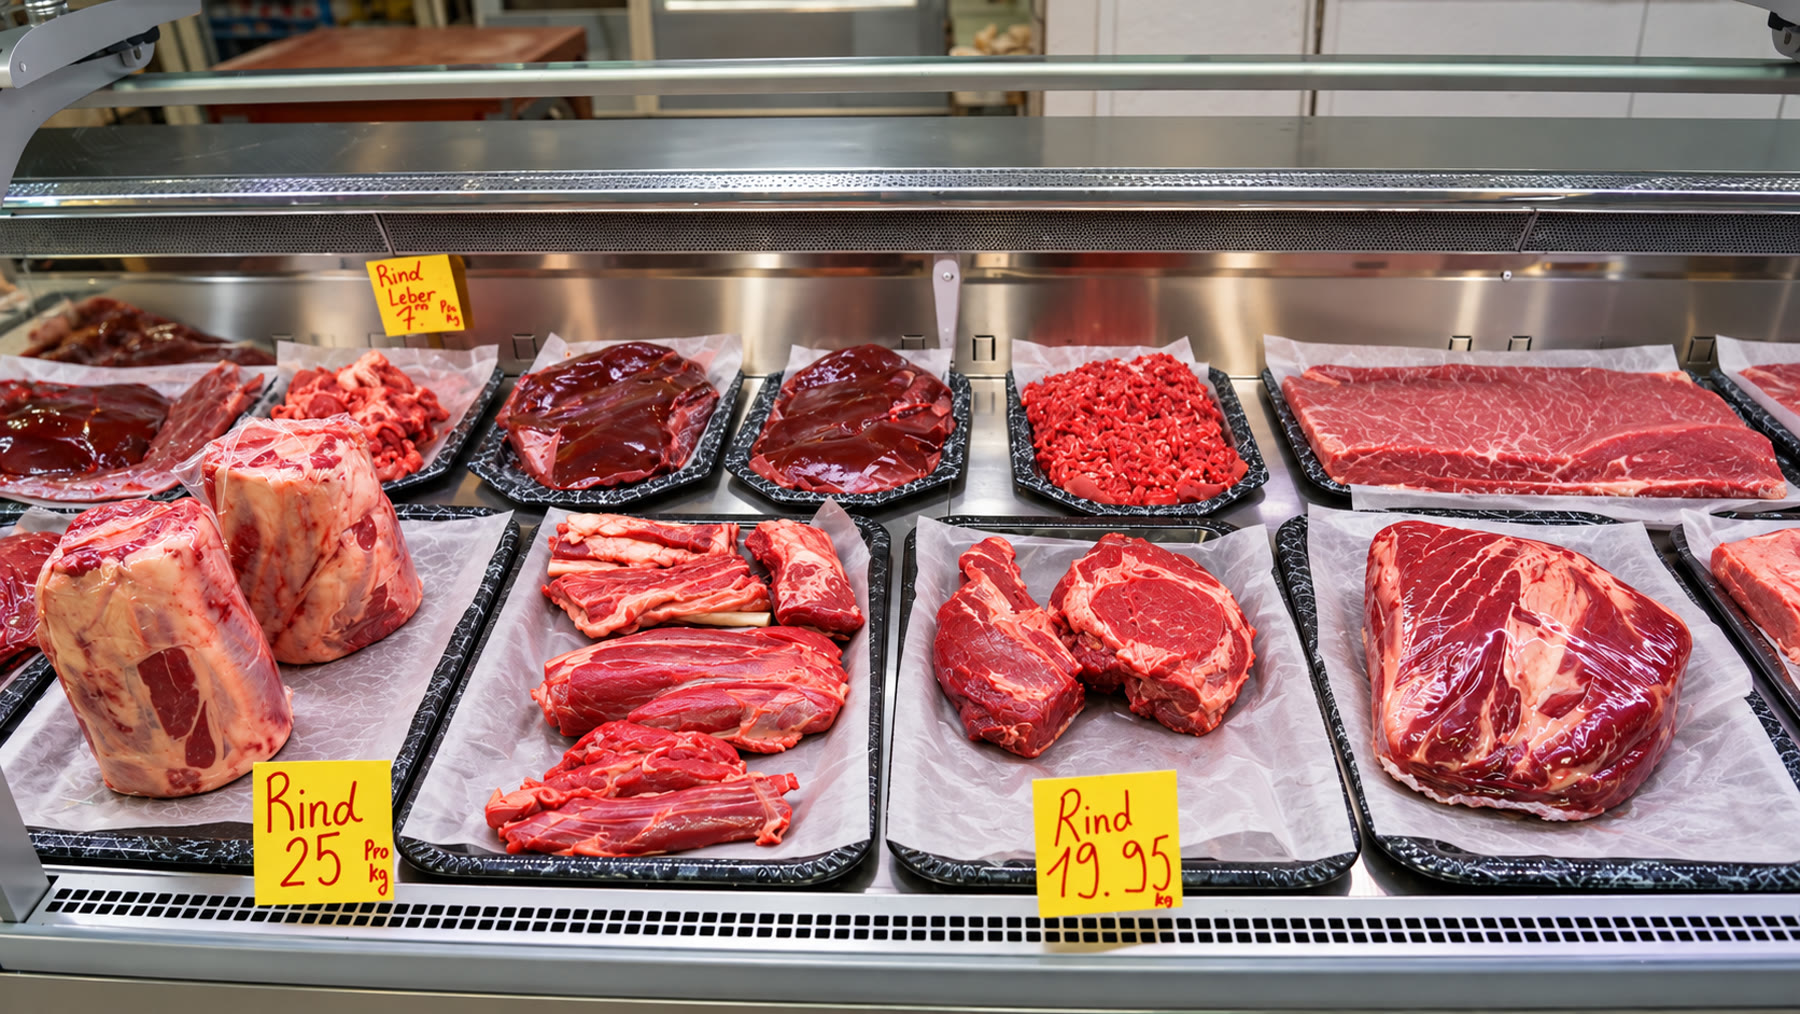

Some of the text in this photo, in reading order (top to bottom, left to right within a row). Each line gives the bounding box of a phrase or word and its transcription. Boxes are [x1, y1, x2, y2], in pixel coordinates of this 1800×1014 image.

[376, 260, 424, 288] Rind
[388, 286, 437, 307] Leber
[266, 771, 364, 833] Rind
[1054, 788, 1133, 847] Rind
[280, 831, 389, 887] 25 Pro
[369, 863, 388, 896] kg
[1154, 892, 1173, 908] kg
